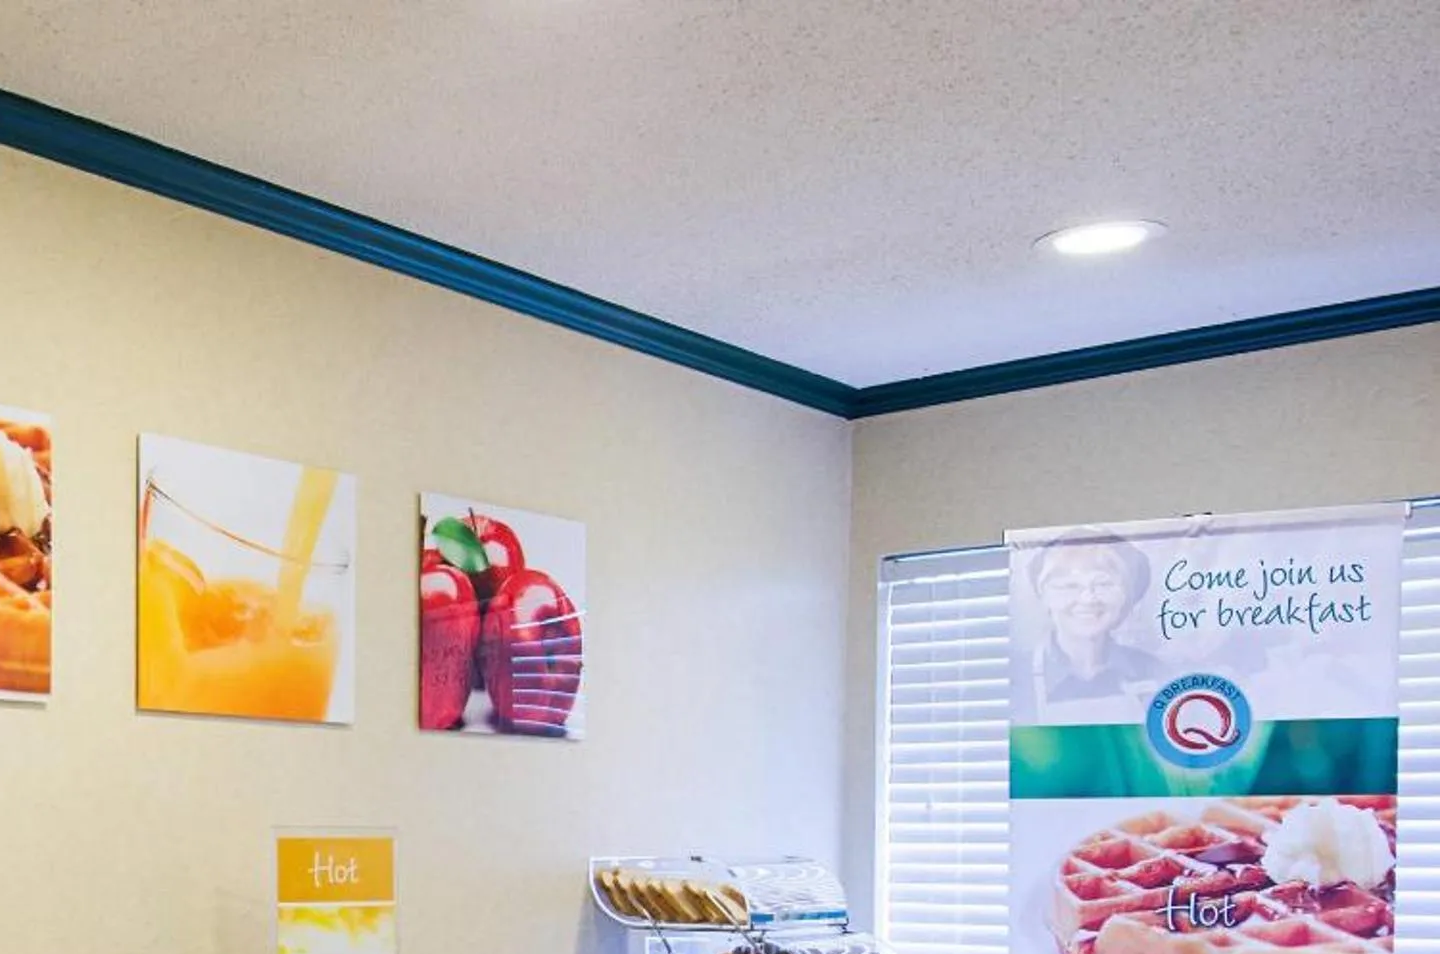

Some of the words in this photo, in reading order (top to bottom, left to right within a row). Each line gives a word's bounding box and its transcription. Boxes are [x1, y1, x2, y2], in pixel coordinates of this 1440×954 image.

[1164, 558, 1249, 594] Come
[1253, 557, 1318, 601] join
[1328, 562, 1365, 585] us
[1156, 600, 1207, 641] for
[1217, 593, 1373, 635] breakfast
[1162, 676, 1241, 700] BREAKFAST
[1165, 693, 1241, 751] Q
[306, 850, 360, 889] Hot
[1154, 887, 1237, 931] Hot
